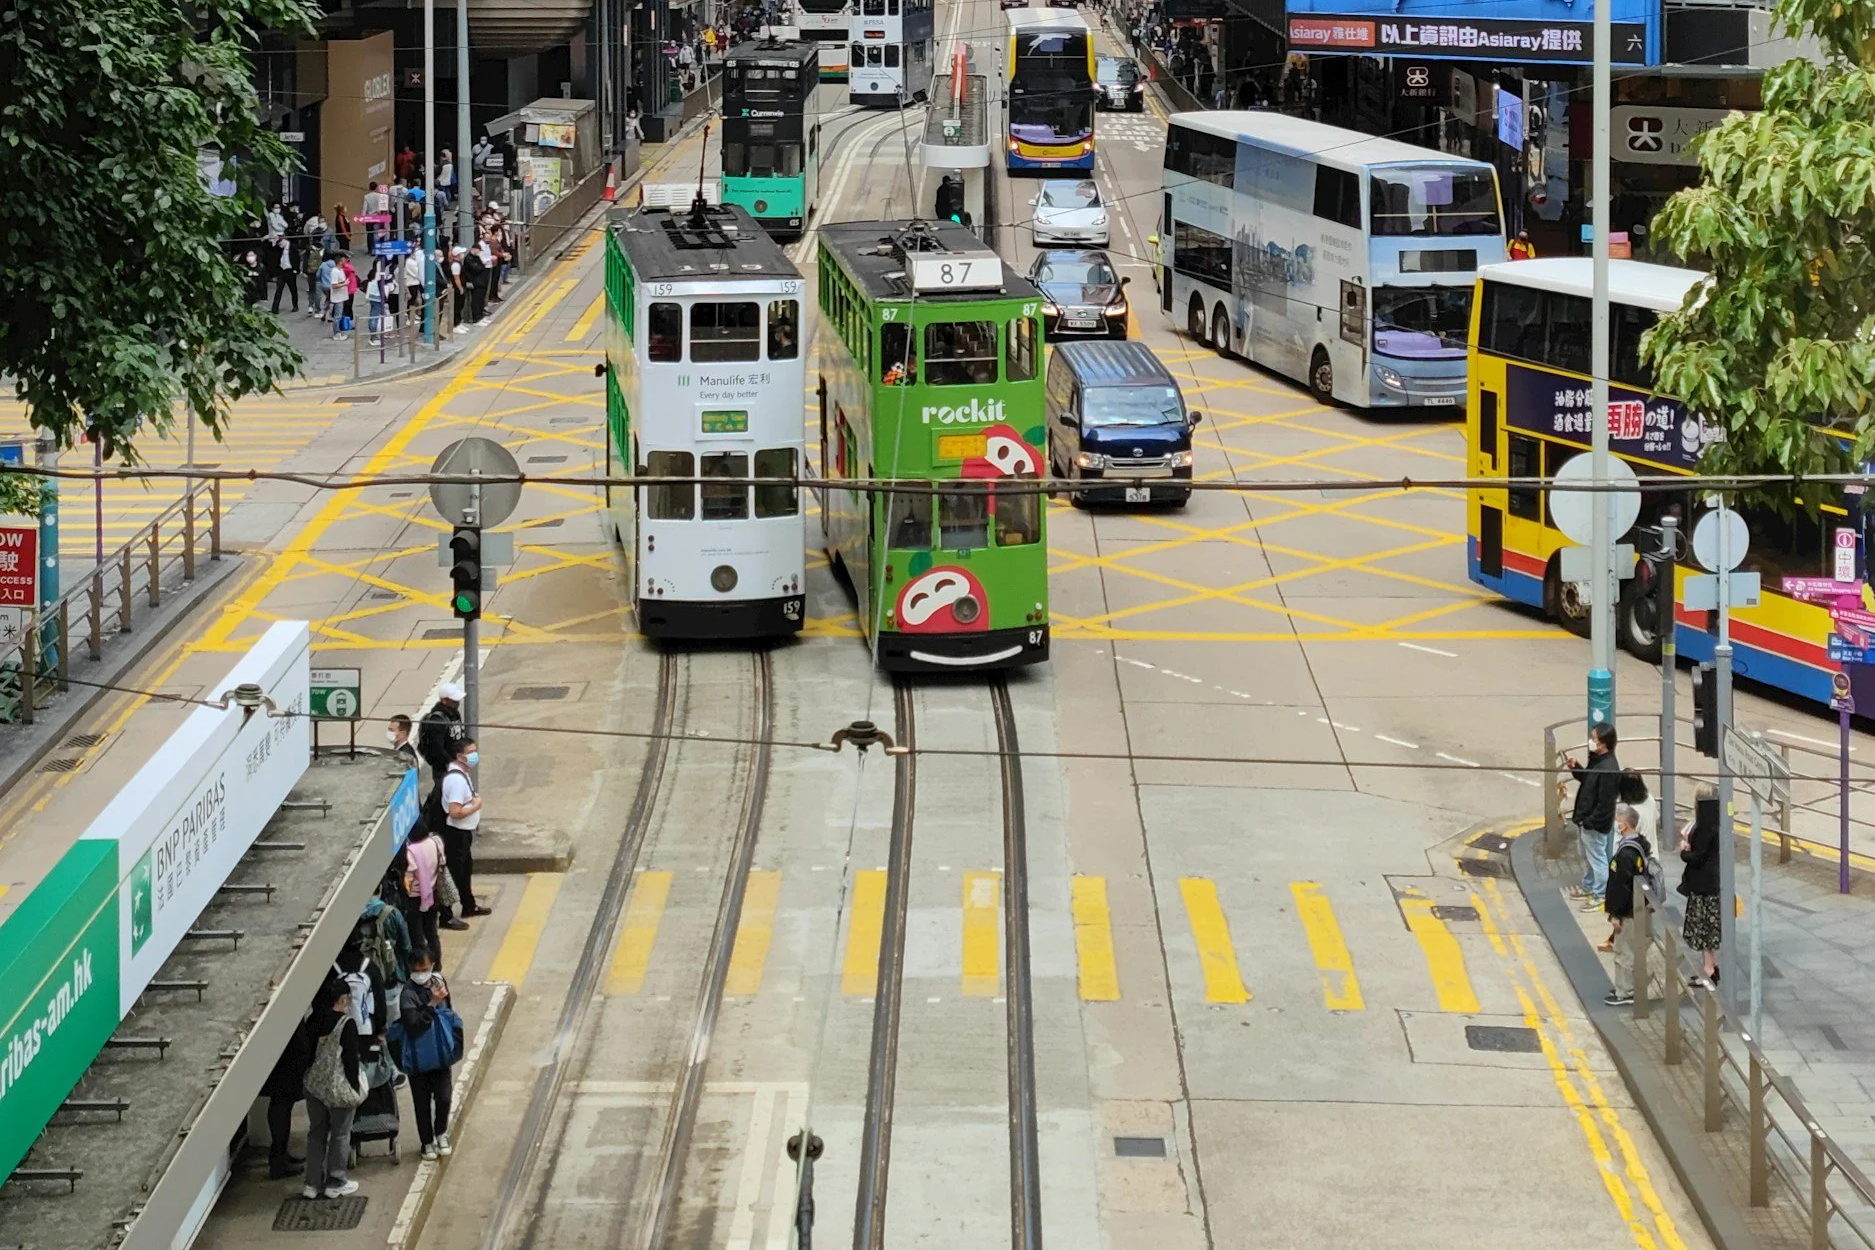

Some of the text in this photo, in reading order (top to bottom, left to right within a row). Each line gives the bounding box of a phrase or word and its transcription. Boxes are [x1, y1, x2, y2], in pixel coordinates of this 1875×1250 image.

[940, 262, 973, 284] 87
[654, 284, 673, 296] 159
[780, 281, 797, 293] 159
[882, 308, 898, 321] 87
[1022, 303, 1038, 316] 87
[700, 373, 771, 386] Manulife 宏利
[700, 390, 759, 400] Every day better
[922, 398, 1007, 425] rockit
[1838, 551, 1852, 579] 中環
[783, 600, 801, 614] 159
[1028, 630, 1044, 646] 87
[156, 771, 226, 881] BNP PARIBAS
[0, 948, 92, 1099] ribas-am.hk
